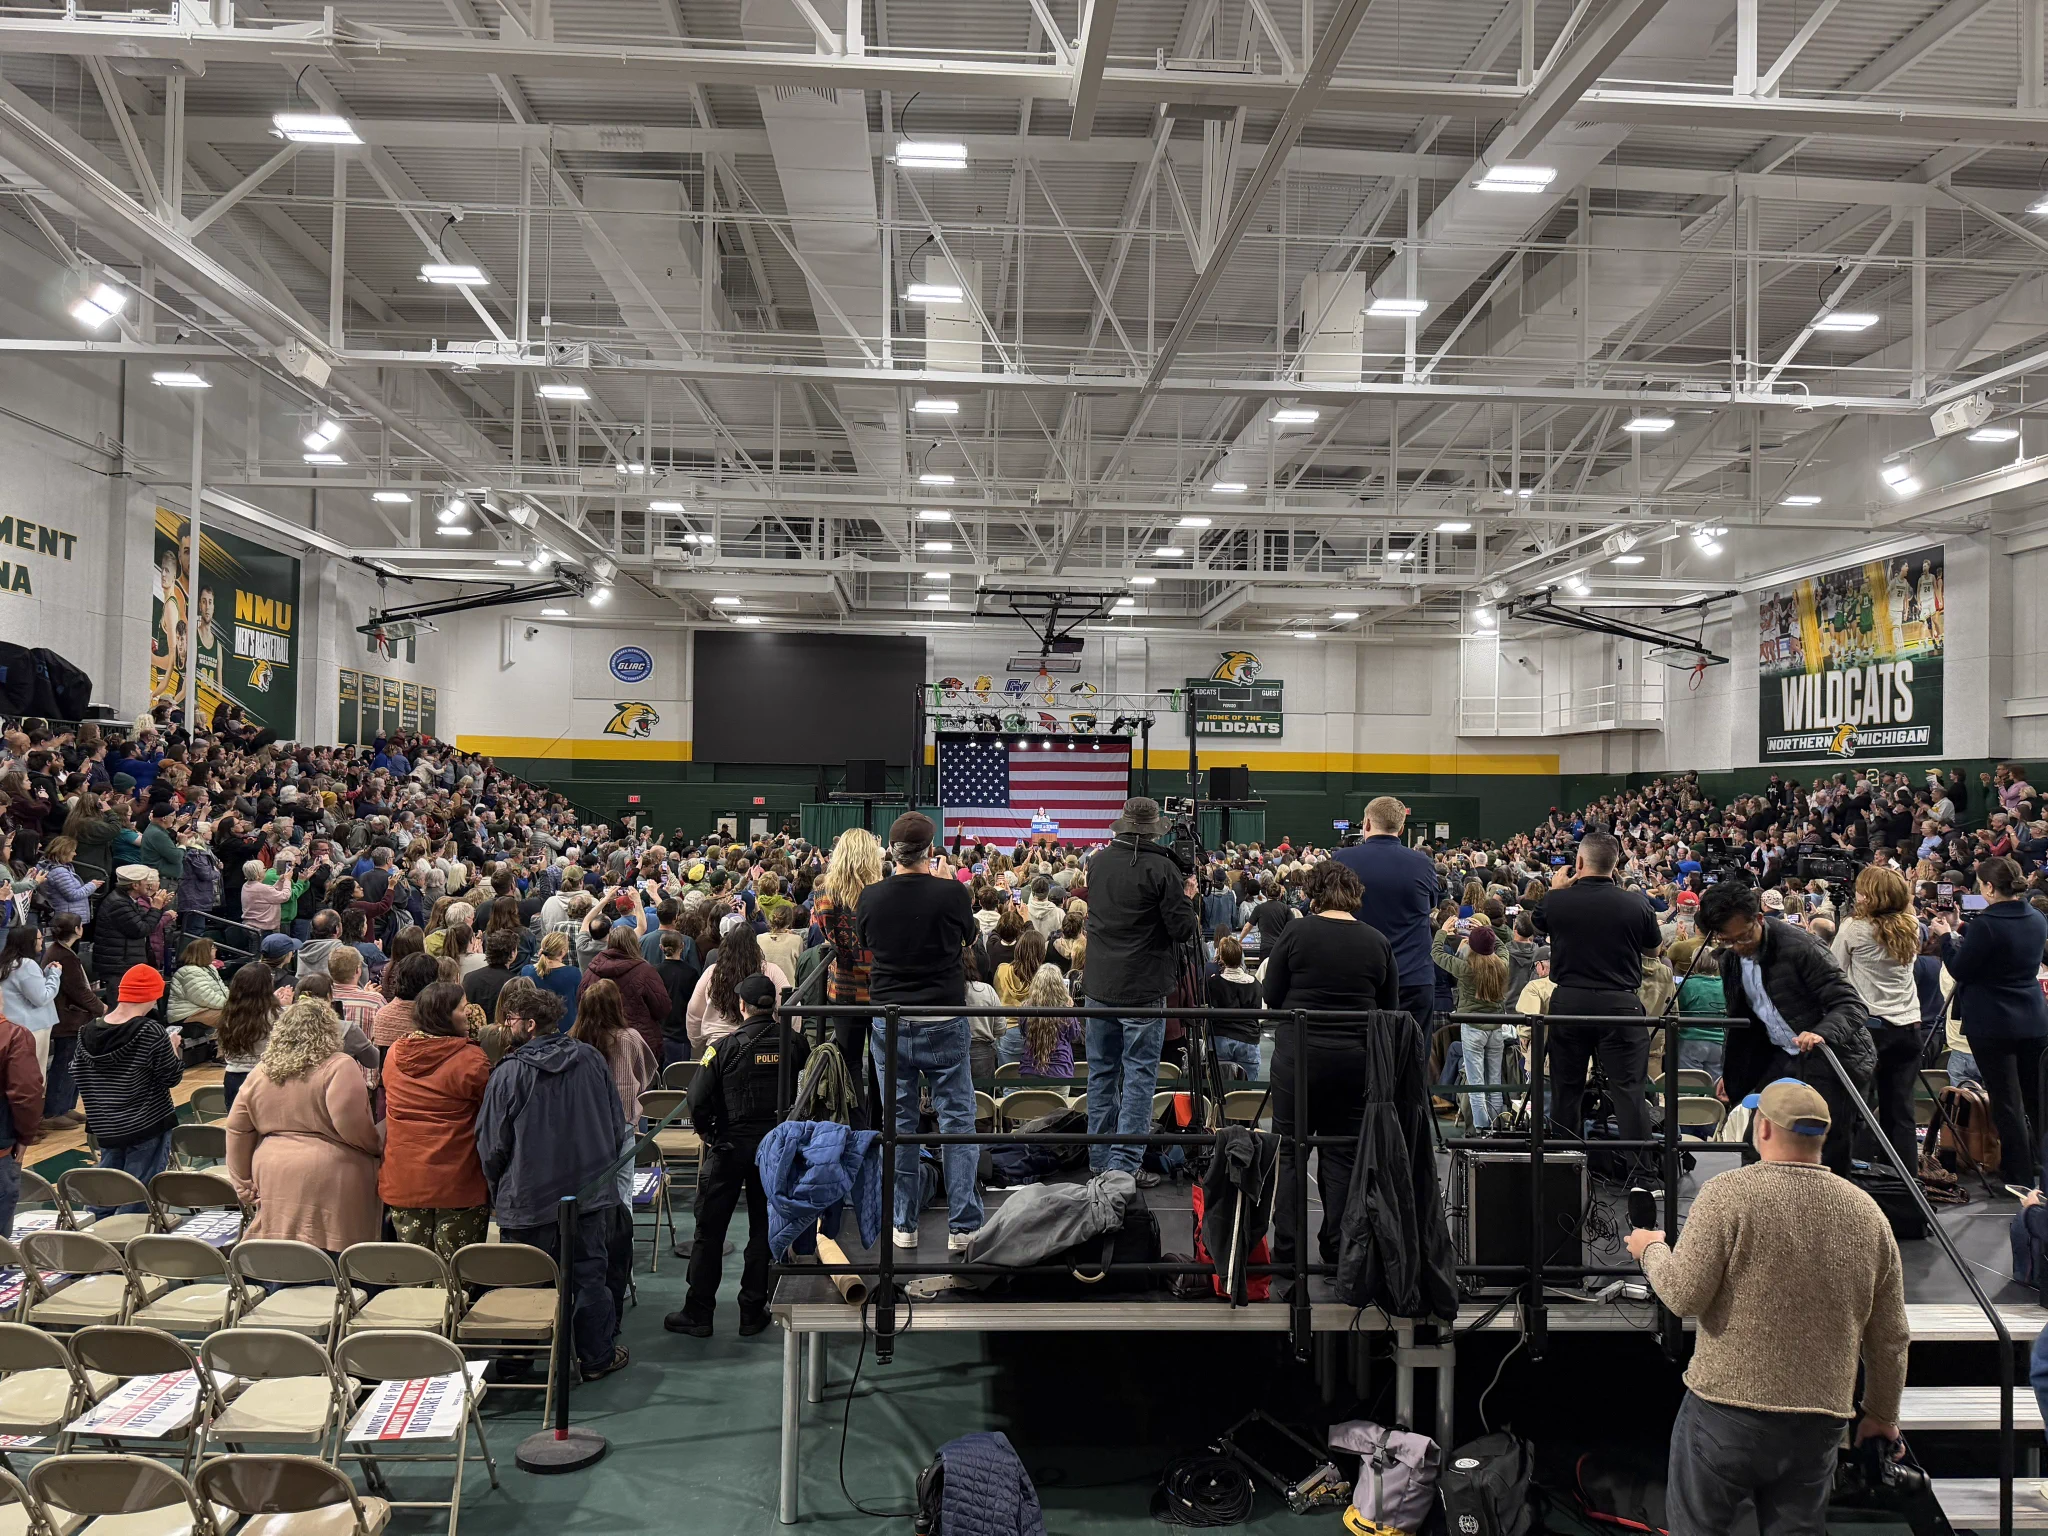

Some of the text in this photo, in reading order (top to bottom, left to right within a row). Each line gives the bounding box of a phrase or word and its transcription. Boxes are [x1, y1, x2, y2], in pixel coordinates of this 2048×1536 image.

[235, 588, 292, 631] NMU
[235, 625, 289, 664] MEN'S BASKETBALL
[617, 662, 646, 670] GLIAC
[1781, 660, 1914, 732] WILDCATS
[1768, 728, 1928, 751] NORTHERN MICHIGAN
[1866, 768, 1880, 787] 2
[756, 1055, 780, 1063] POLIC
[395, 1404, 412, 1412] IN
[400, 1389, 421, 1404] YOUR
[406, 1396, 443, 1433] MEDICARE
[425, 1380, 449, 1395] FOR
[122, 1392, 185, 1429] MEDICARE
[364, 1415, 387, 1435] MONEY
[376, 1402, 394, 1413] OUT
[384, 1413, 408, 1434] MONEY
